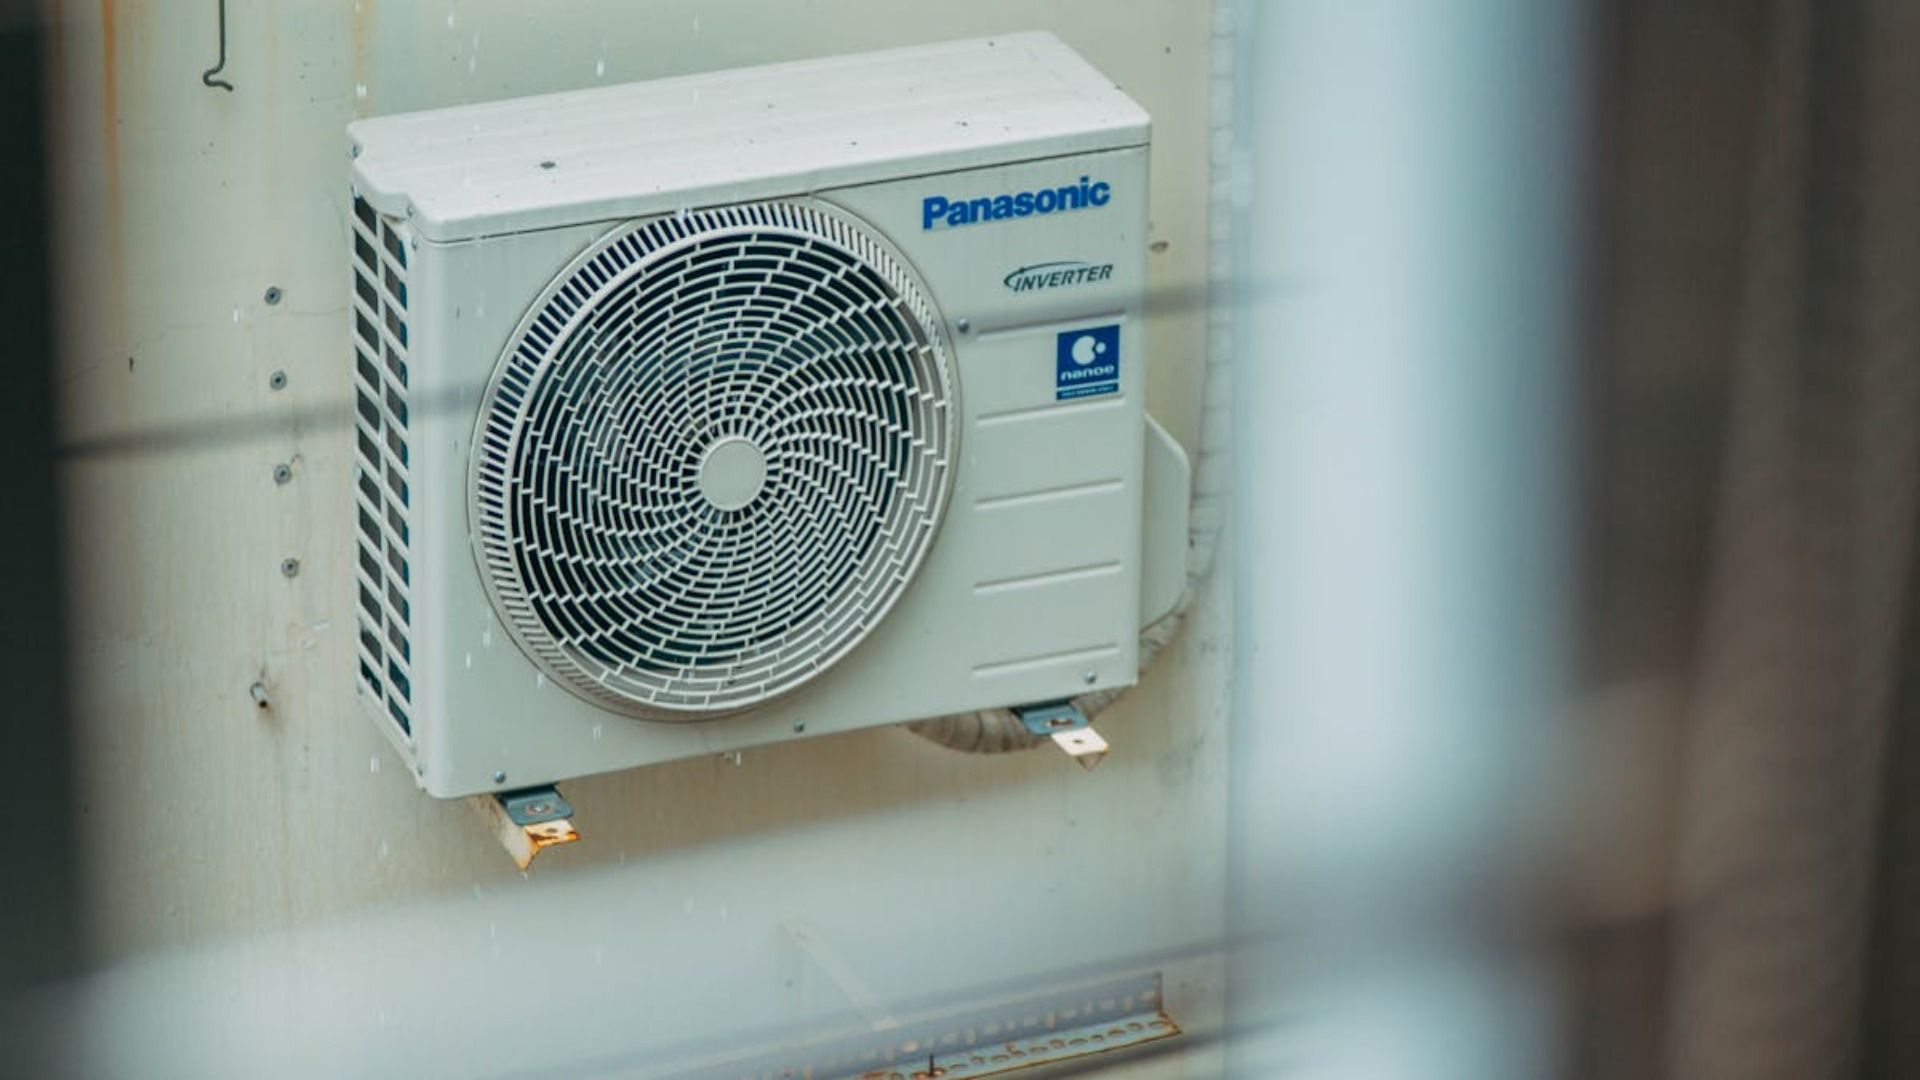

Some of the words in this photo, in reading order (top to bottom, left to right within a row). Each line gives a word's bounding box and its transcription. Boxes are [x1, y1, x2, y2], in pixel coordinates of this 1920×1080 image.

[922, 176, 1111, 230] Panasonic
[1011, 263, 1113, 292] INVERTER
[1061, 365, 1115, 381] nanoe
